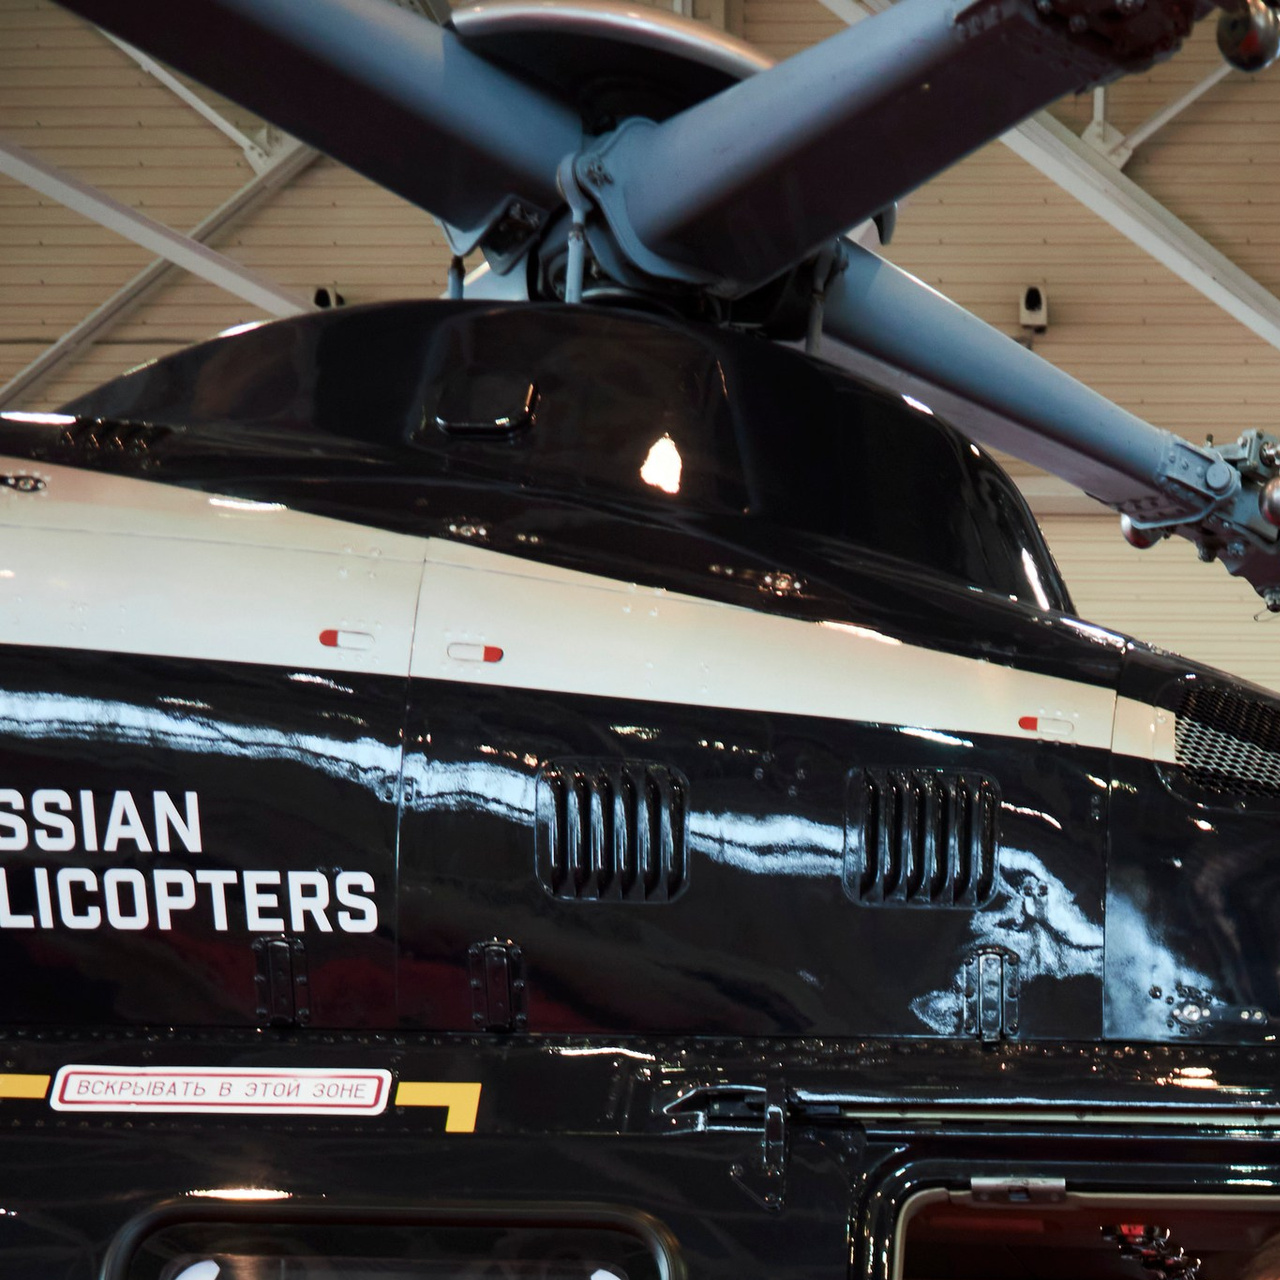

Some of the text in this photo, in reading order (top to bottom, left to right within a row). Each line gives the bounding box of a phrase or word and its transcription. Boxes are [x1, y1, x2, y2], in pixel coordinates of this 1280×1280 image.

[0, 788, 203, 853] SSIAN
[0, 867, 379, 933] LICOPTERS
[76, 1078, 367, 1099] ВСКРЫВАТЬ В ЭТОЙ ЗОНЕ
